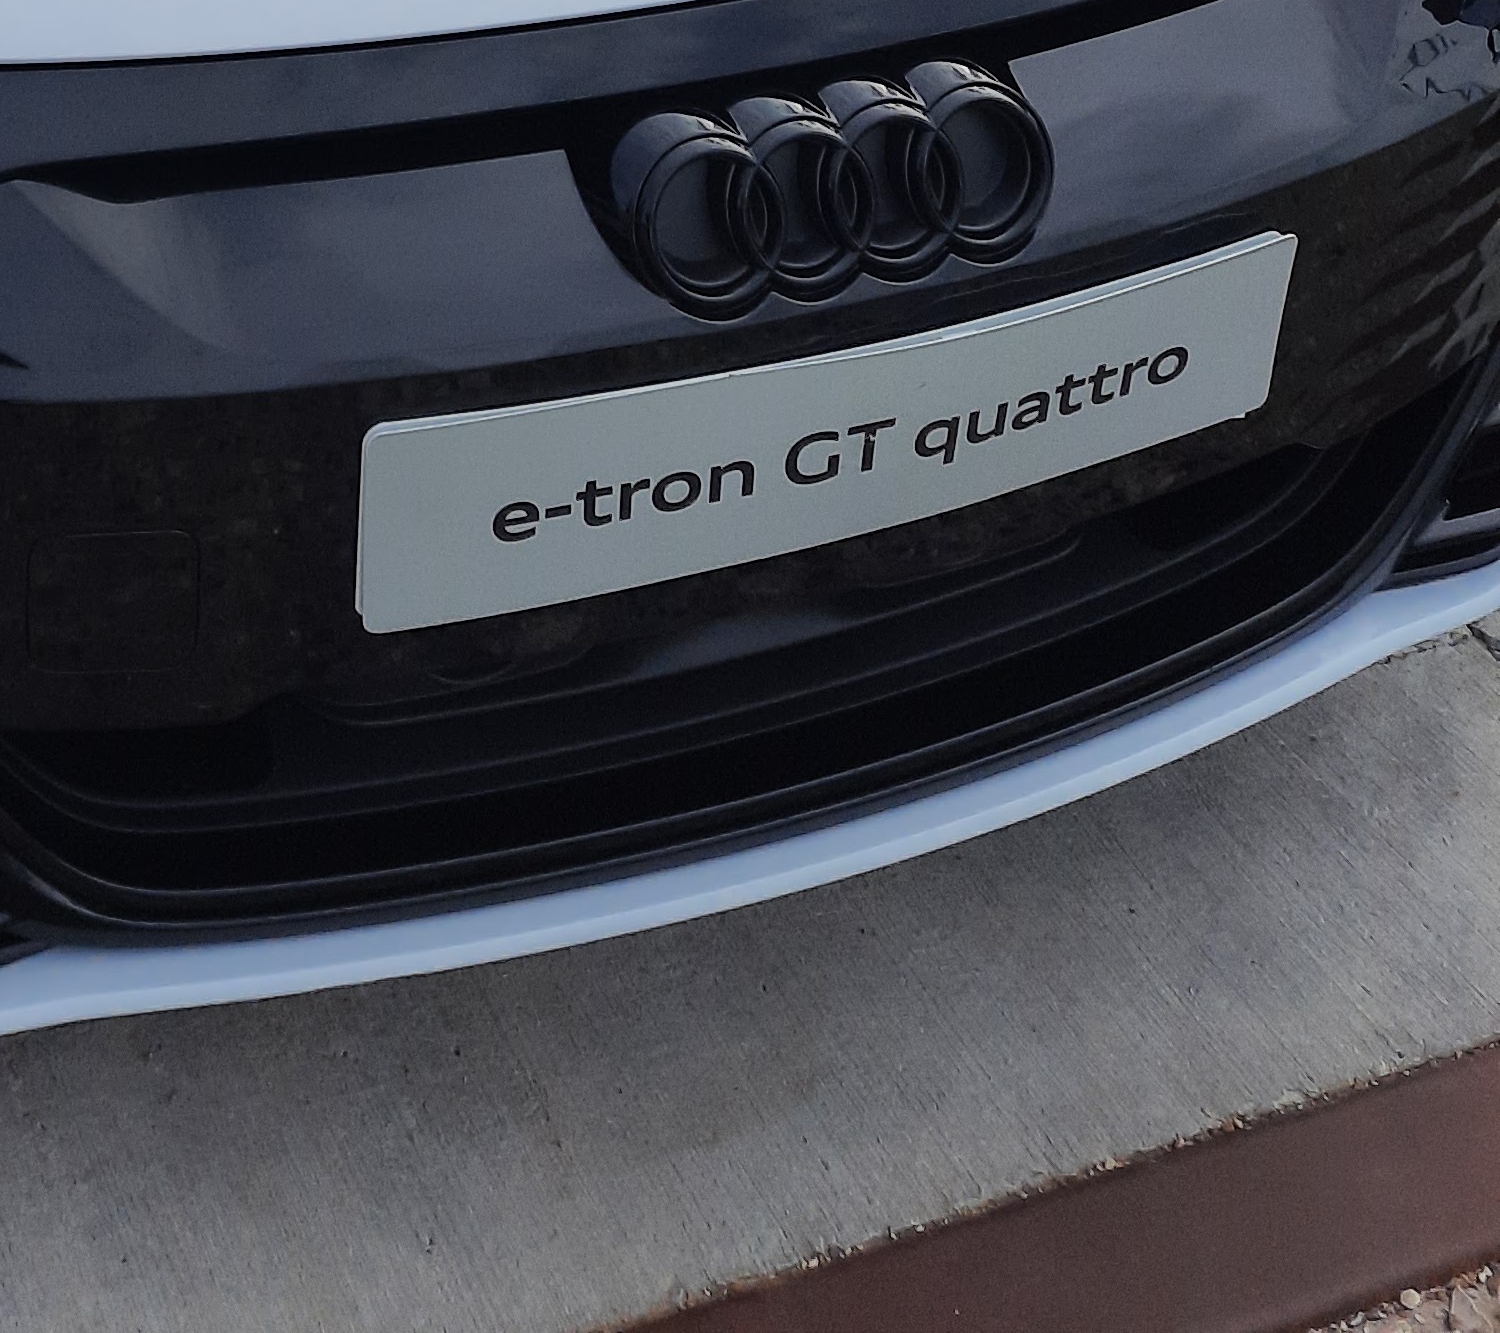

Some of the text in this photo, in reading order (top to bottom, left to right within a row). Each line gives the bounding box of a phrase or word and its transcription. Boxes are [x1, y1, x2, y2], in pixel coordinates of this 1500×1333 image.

[492, 344, 1191, 544] e-tron GT quattro
